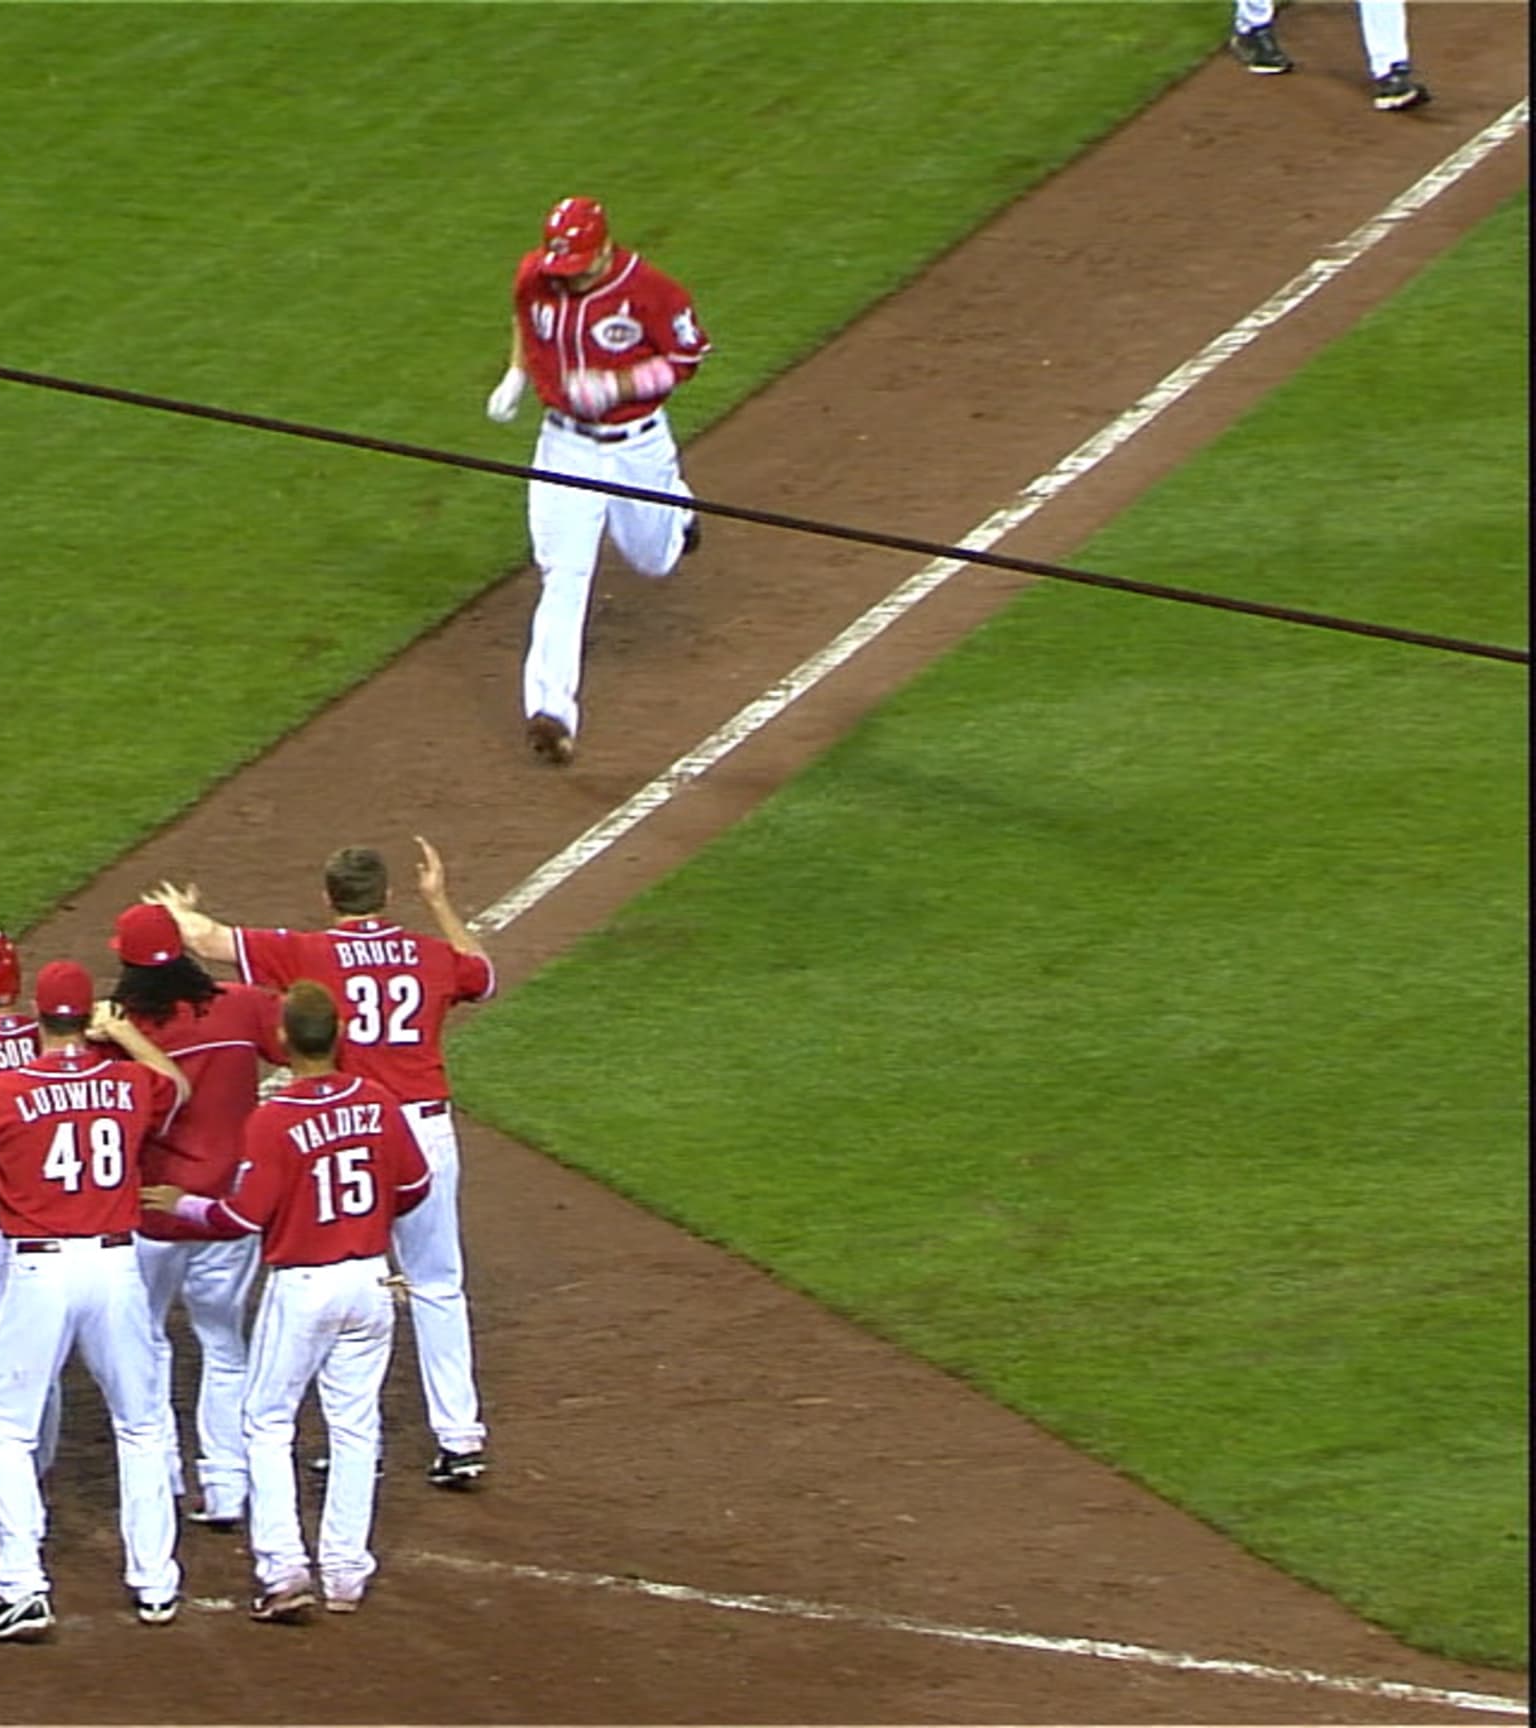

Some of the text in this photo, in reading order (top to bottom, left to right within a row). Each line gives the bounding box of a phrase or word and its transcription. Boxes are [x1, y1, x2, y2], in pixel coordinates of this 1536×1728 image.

[335, 938, 419, 968] BRUCE
[345, 974, 421, 1045] 32
[15, 1079, 134, 1123] LUDWICK
[287, 1103, 384, 1154] VALDEZ
[42, 1117, 124, 1193] 48
[311, 1146, 375, 1224] 15
